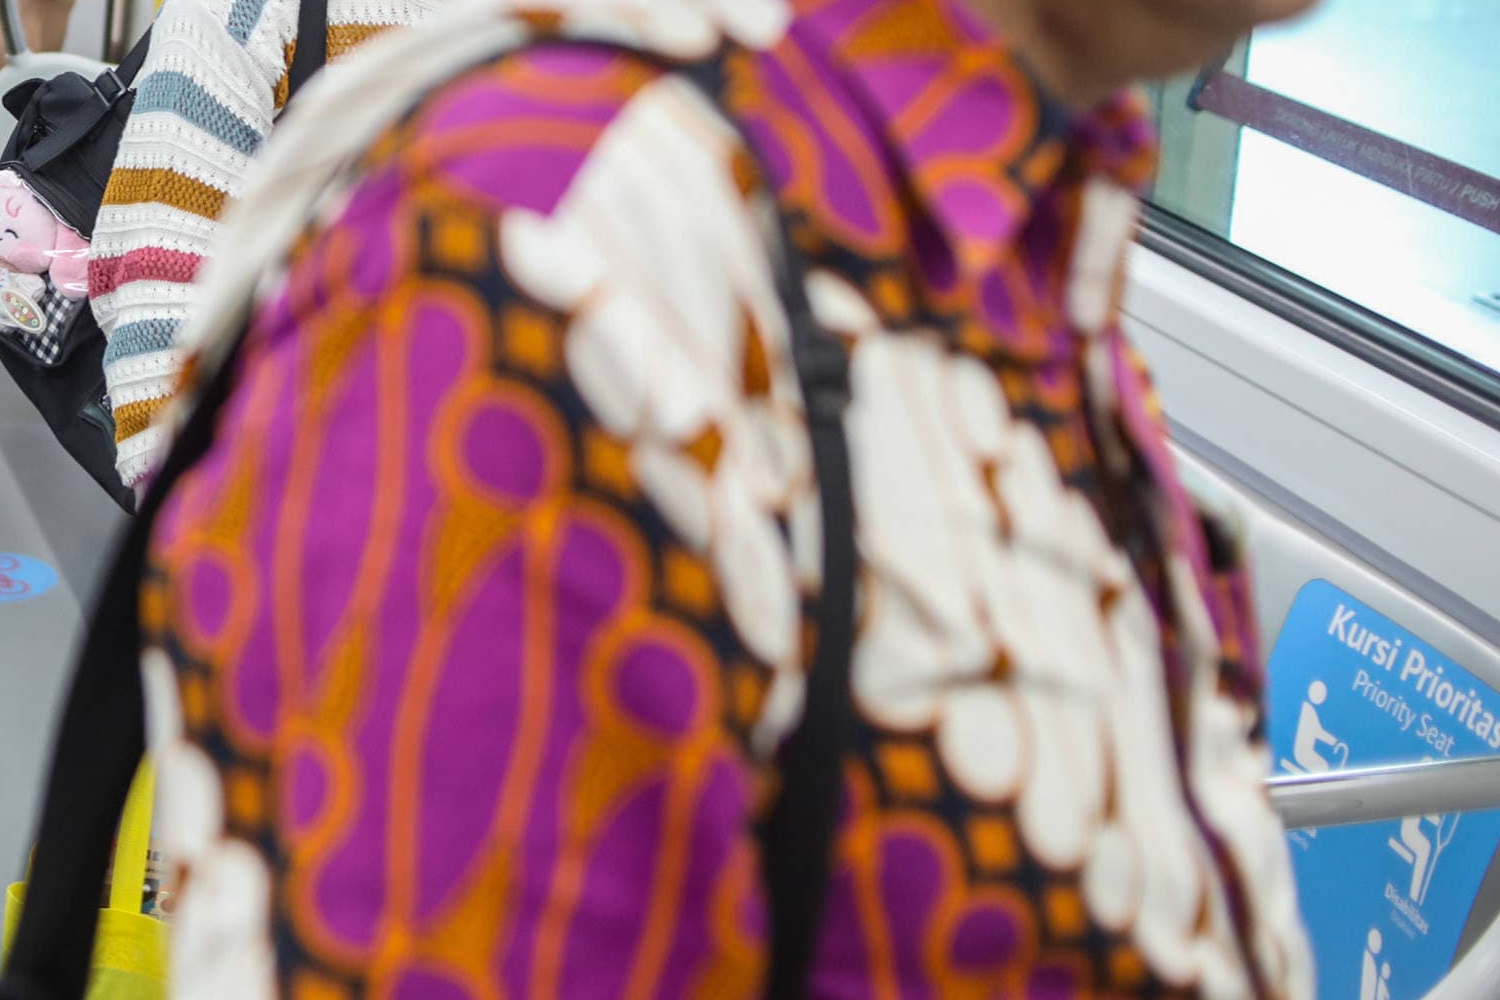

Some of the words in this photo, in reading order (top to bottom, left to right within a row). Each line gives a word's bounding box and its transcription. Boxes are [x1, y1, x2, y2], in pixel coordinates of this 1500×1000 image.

[1459, 183, 1500, 210] PUSH
[1327, 603, 1402, 671] Kursi
[1401, 649, 1500, 748] Prioritas
[1352, 669, 1417, 731] Priority
[1416, 714, 1456, 757] Seat
